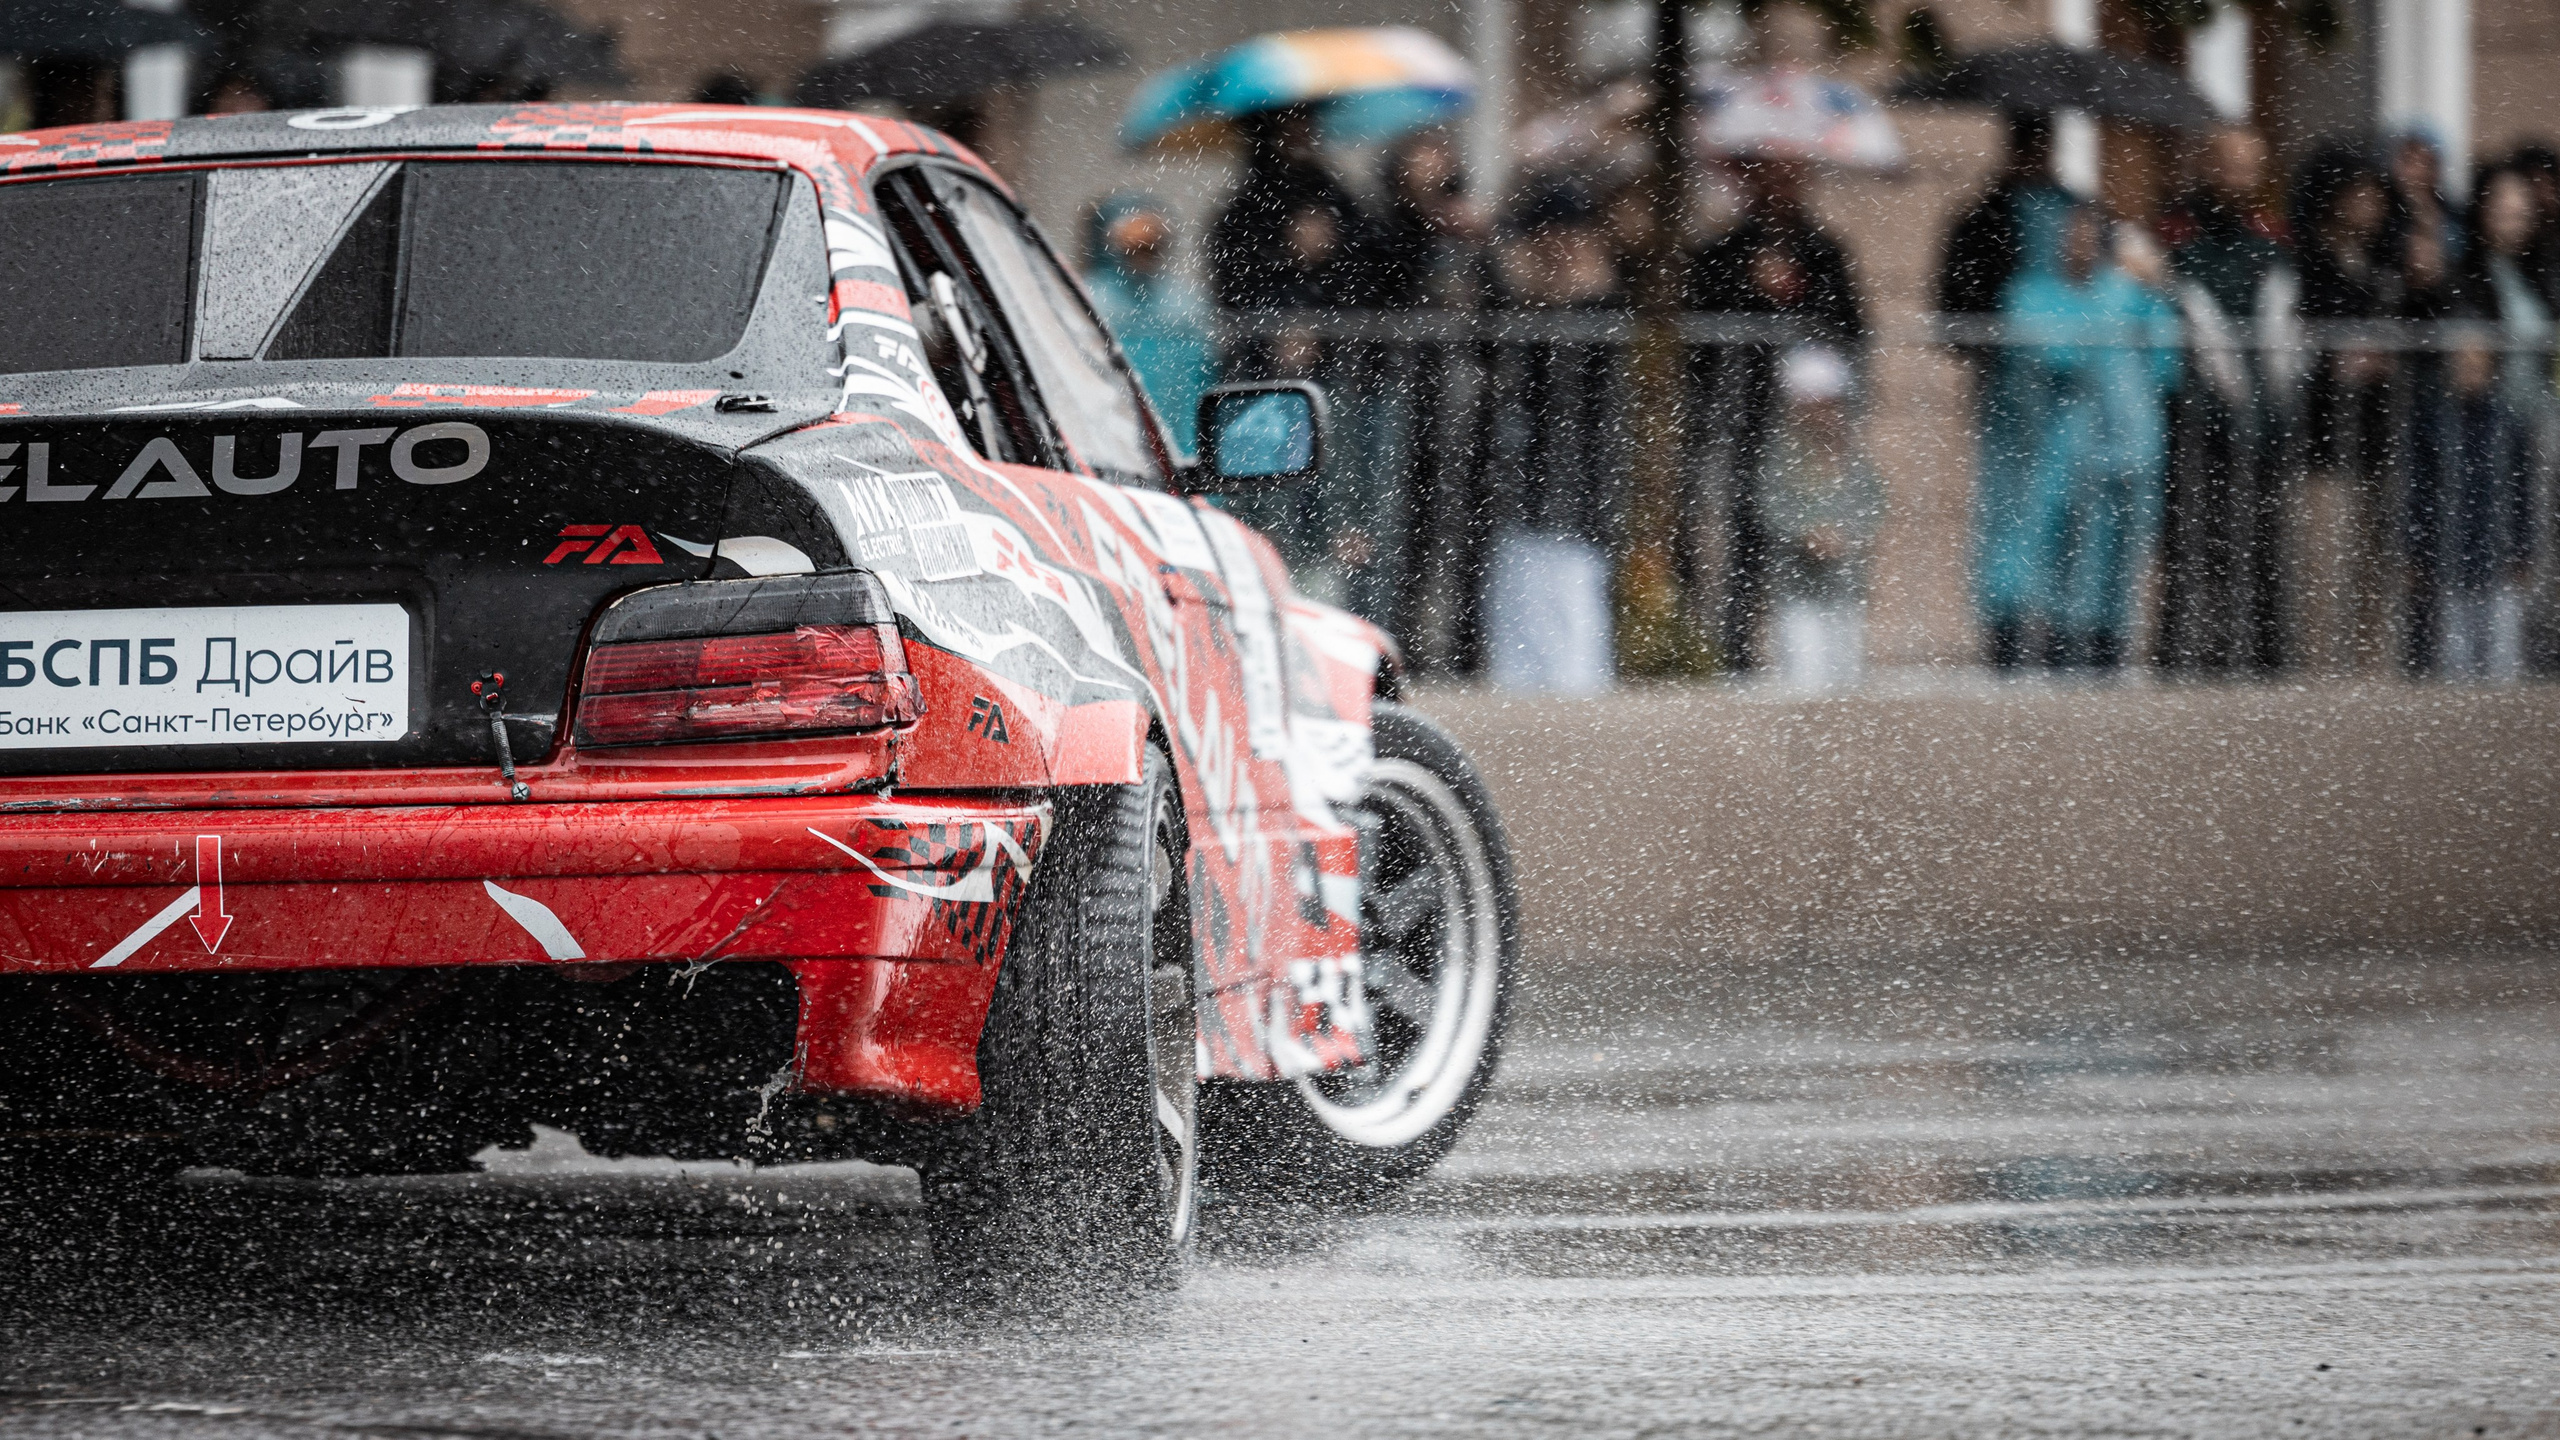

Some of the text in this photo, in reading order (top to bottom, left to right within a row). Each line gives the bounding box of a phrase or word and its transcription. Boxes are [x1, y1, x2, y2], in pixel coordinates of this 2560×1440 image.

[542, 524, 664, 564] FA
[858, 534, 906, 562] ELECTRIC
[0, 637, 394, 697] БСПБ Драйв
[0, 706, 393, 738] Банк «Санкт-Петербург»
[968, 695, 1009, 744] FA
